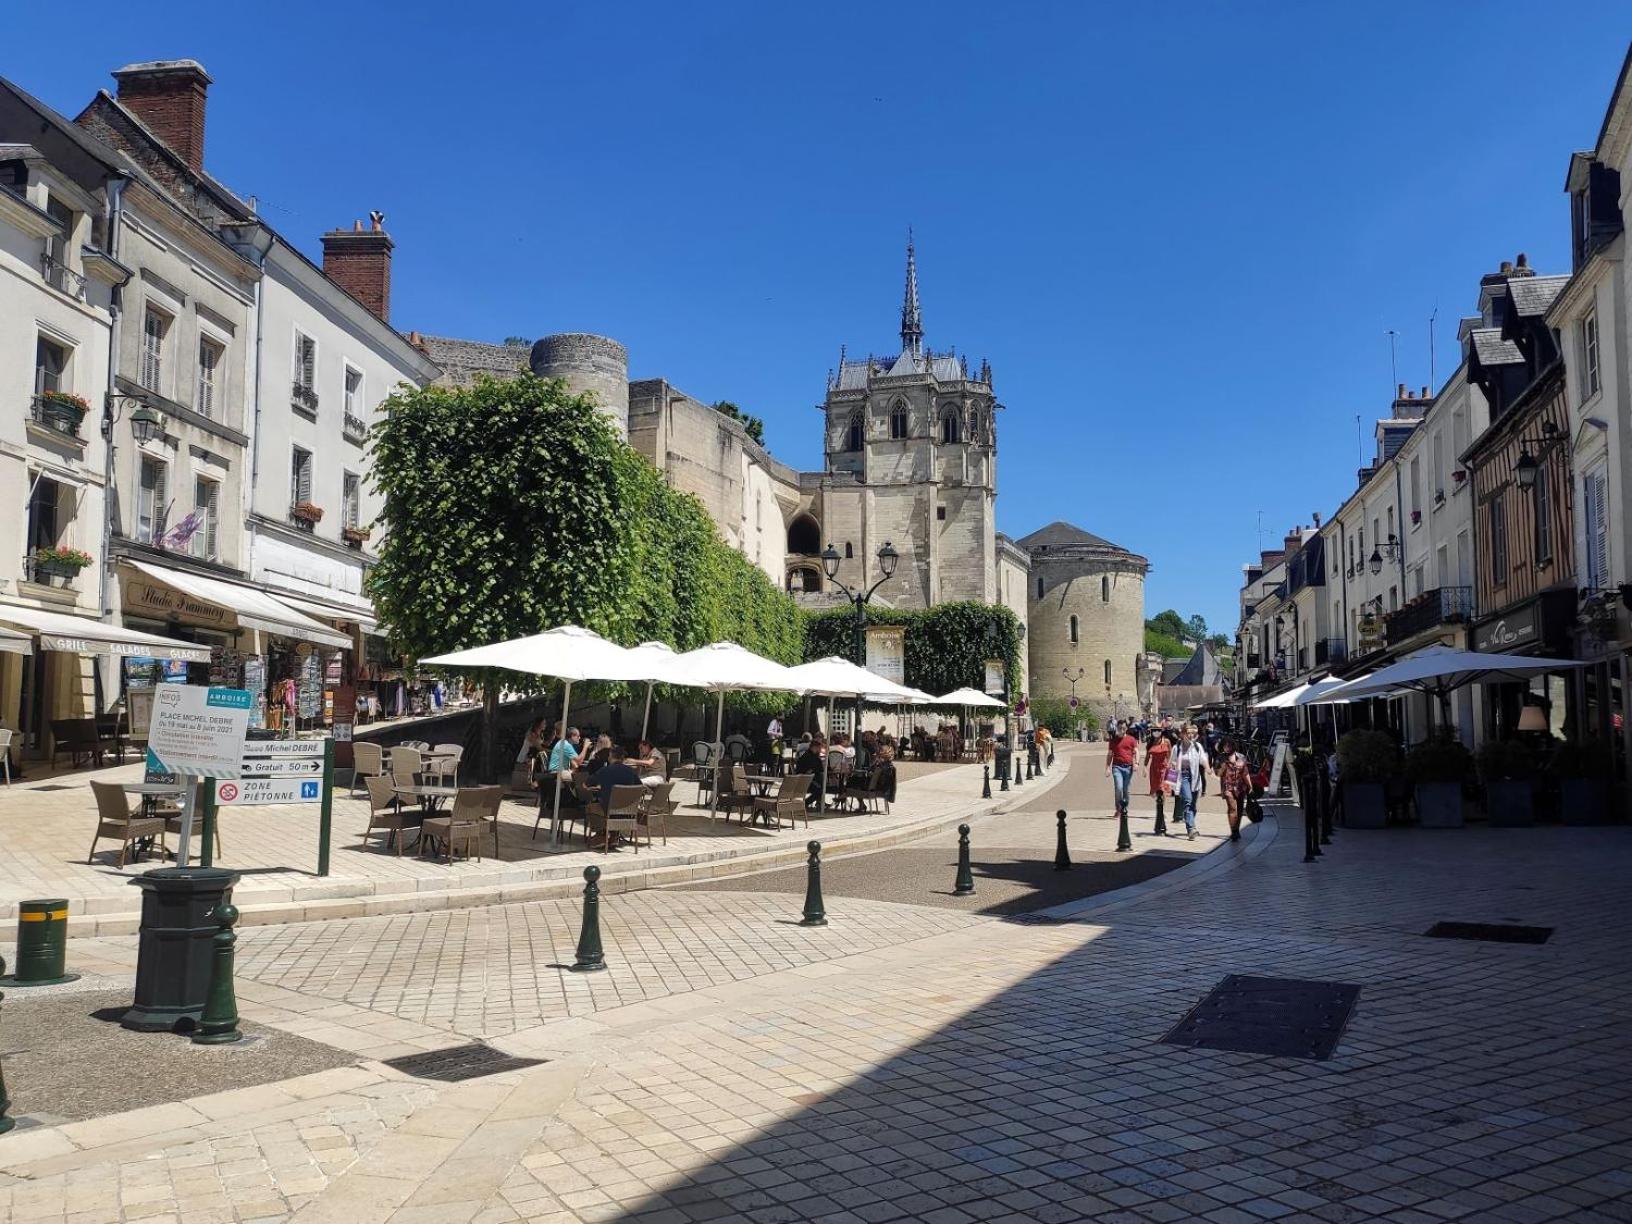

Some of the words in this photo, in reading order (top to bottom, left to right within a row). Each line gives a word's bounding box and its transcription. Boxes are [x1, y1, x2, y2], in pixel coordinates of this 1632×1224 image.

[141, 585, 173, 607] Studio
[110, 642, 151, 656] SALADES
[209, 694, 247, 702] AMBOISE
[160, 711, 181, 720] PLACE
[183, 714, 207, 722] MICHEL
[264, 744, 292, 752] Michel
[255, 763, 283, 771] Gratuit
[289, 763, 301, 771] 50
[243, 782, 272, 790] ZONE
[243, 791, 295, 801] PIÉTONNE
